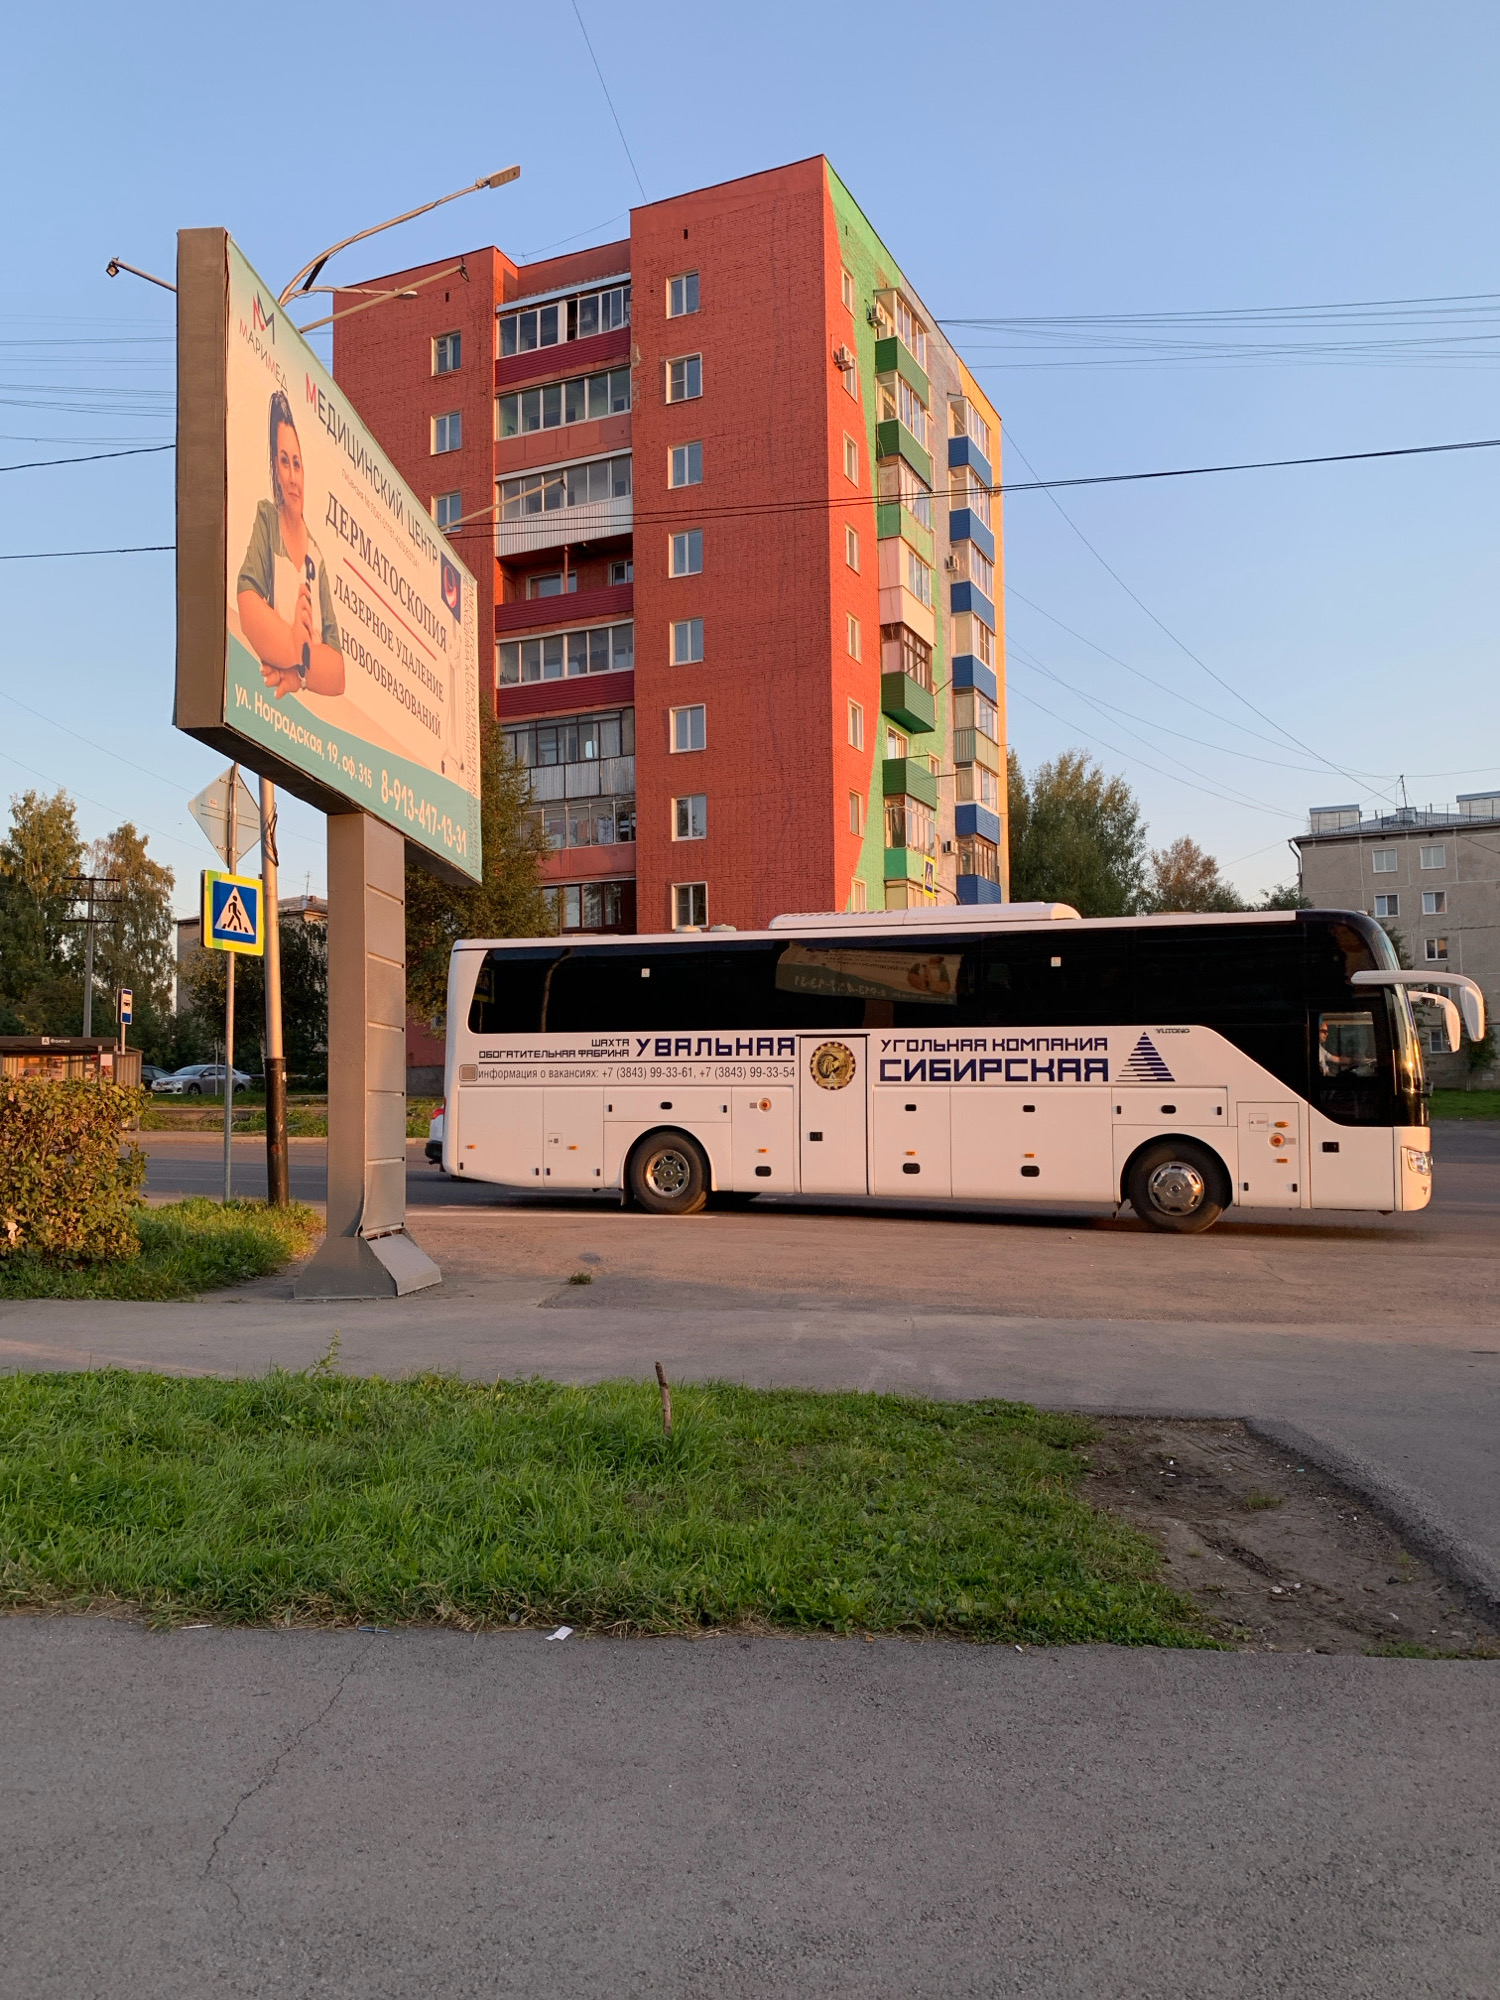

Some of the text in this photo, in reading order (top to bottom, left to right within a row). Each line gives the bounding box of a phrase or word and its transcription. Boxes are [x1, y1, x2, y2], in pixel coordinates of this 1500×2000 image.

[240, 317, 288, 393] МАРИМЕД
[305, 372, 438, 567] МЕДИЦИНСКИЙ ЦЕНТР
[325, 491, 447, 653] ДЕРМАТОСКОПИЯ
[334, 573, 444, 702] ЛАЗЕРНОЕ УДАЛЕНИЕ
[341, 626, 440, 739] НОВООБРАЗОВАНИЙ
[235, 683, 373, 789] ул. Ноградская, 19, оф. 315
[380, 768, 467, 857] 8-913-417-13-31
[478, 1049, 630, 1059] ОБОГАТИТЕЛЬНАЯ ФАБРИКА
[478, 1068, 538, 1080] информация
[549, 1069, 599, 1078] вакансиях:
[601, 1067, 613, 1078] +7
[616, 1066, 647, 1080] (3843)
[649, 1066, 697, 1079] 99-33-61,
[700, 1066, 711, 1077] +7
[714, 1066, 747, 1080] (3843)
[749, 1066, 796, 1078] 99-33-54
[591, 1038, 630, 1047] ШАХТА
[635, 1037, 796, 1057] УВАЛЬНАЯ
[879, 1058, 1109, 1082] СИБИРСКАЯ
[880, 1037, 1108, 1053] УГОЛЬНАЯ КОМПАНИЯ
